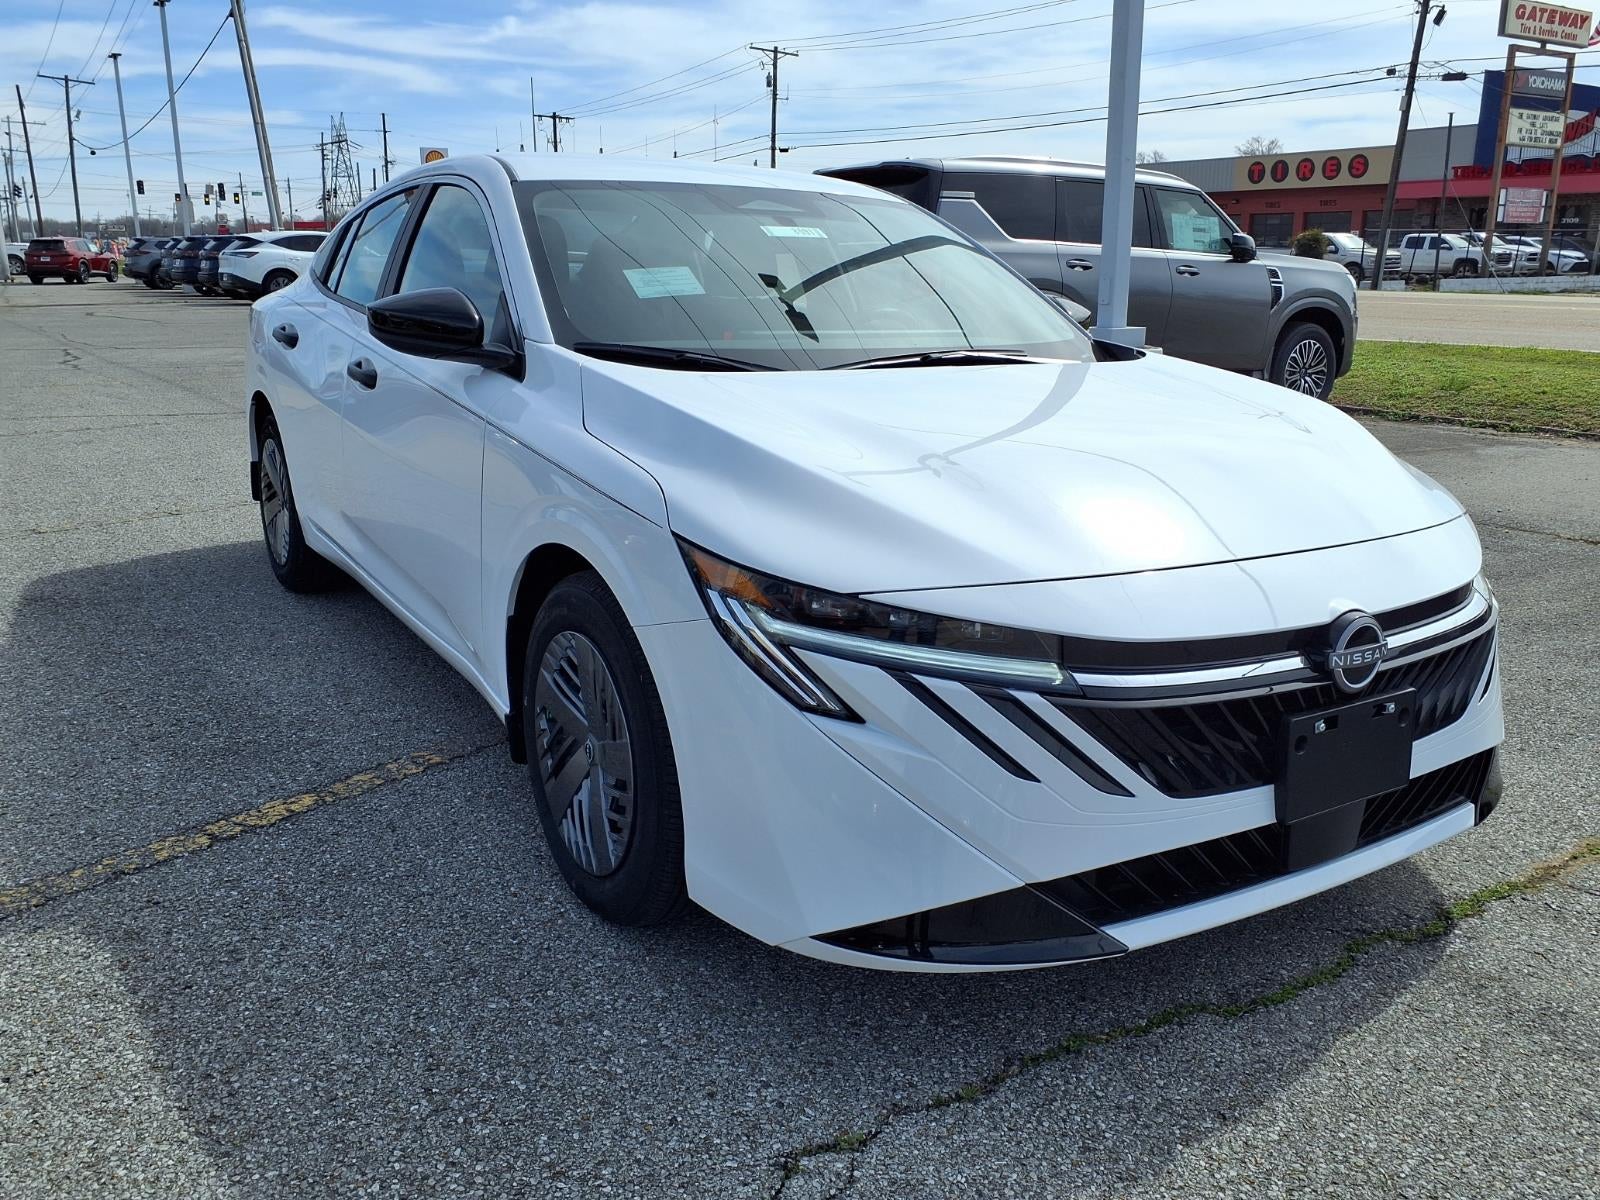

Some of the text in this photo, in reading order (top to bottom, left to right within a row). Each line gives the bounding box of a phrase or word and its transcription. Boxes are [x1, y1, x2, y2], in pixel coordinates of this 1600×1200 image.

[1515, 4, 1590, 30] GATEWAY
[1520, 23, 1531, 34] Tire
[1539, 25, 1558, 39] Service
[1561, 29, 1578, 41] Center
[1528, 75, 1566, 91] YOKOHAMA
[1250, 154, 1366, 182] TIRES
[1332, 646, 1389, 667] NISSAN
